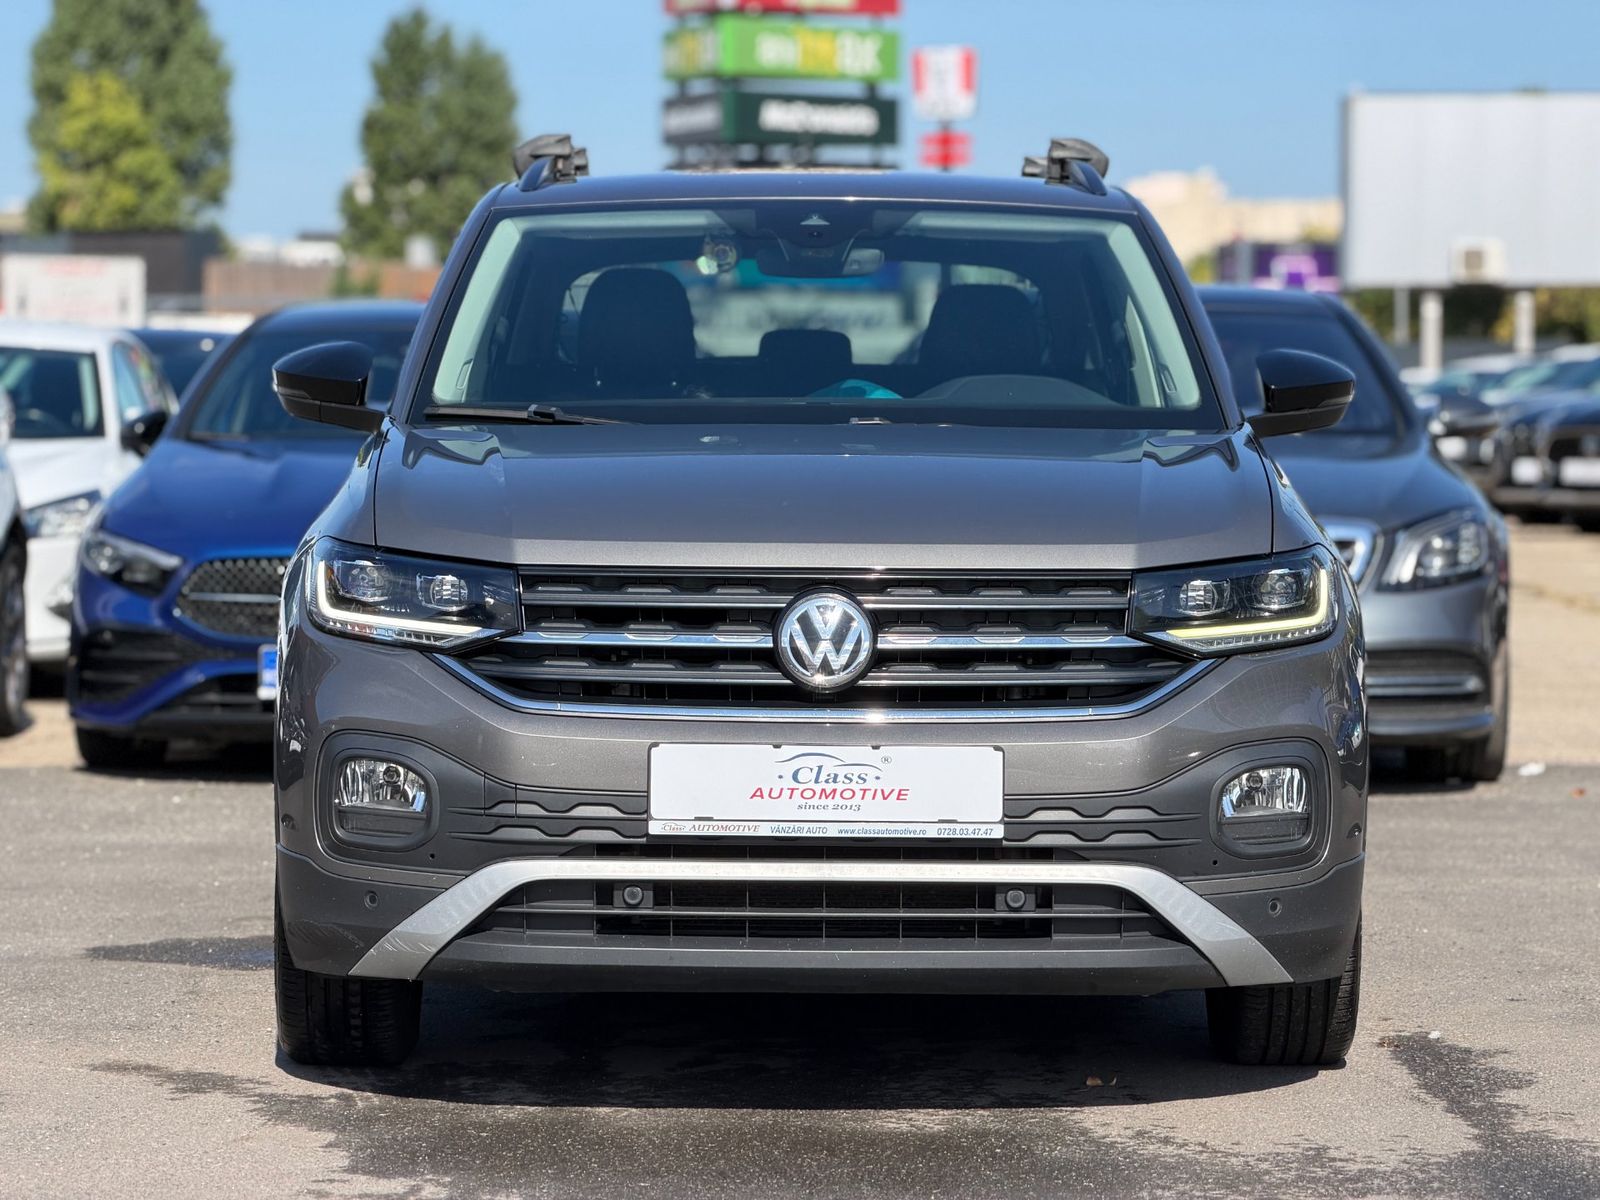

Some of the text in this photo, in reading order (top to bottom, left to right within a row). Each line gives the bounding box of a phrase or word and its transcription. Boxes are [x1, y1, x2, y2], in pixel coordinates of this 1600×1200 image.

[792, 765, 868, 785] Class
[749, 787, 910, 801] AUTOMOTIVE
[796, 802, 862, 812] since 2013
[837, 827, 927, 836] www.classautomotive.ro
[937, 828, 994, 836] 0728.03.47.47
